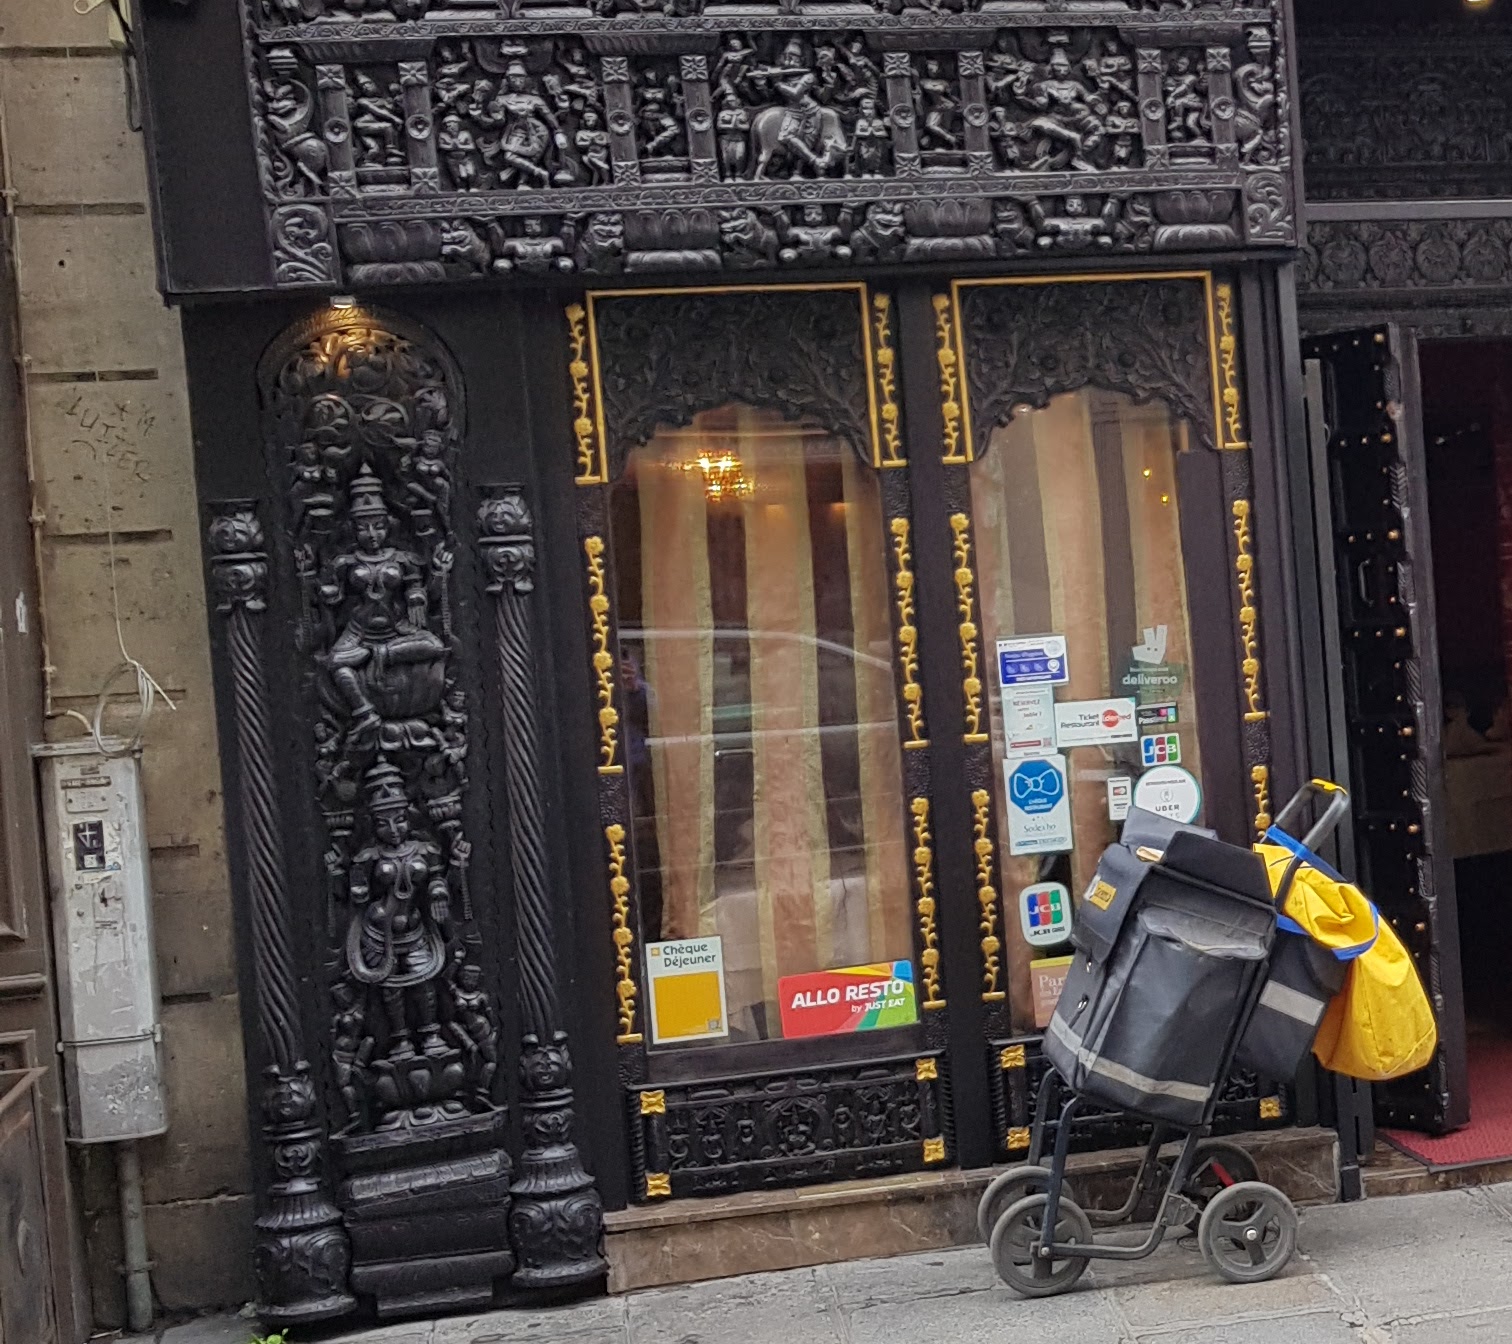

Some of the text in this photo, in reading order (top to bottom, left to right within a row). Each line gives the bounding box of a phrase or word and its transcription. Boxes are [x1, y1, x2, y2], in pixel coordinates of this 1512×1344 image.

[1122, 673, 1178, 685] deliveroo
[1078, 713, 1100, 721] Ticket
[1143, 743, 1177, 757] JCB
[1155, 804, 1180, 812] UBER
[1028, 901, 1062, 915] JCB
[662, 940, 708, 957] Chèque
[663, 953, 717, 969] Déjeuner
[791, 979, 905, 1009] ALLO RESTO
[851, 997, 906, 1013] by JUST EAT
